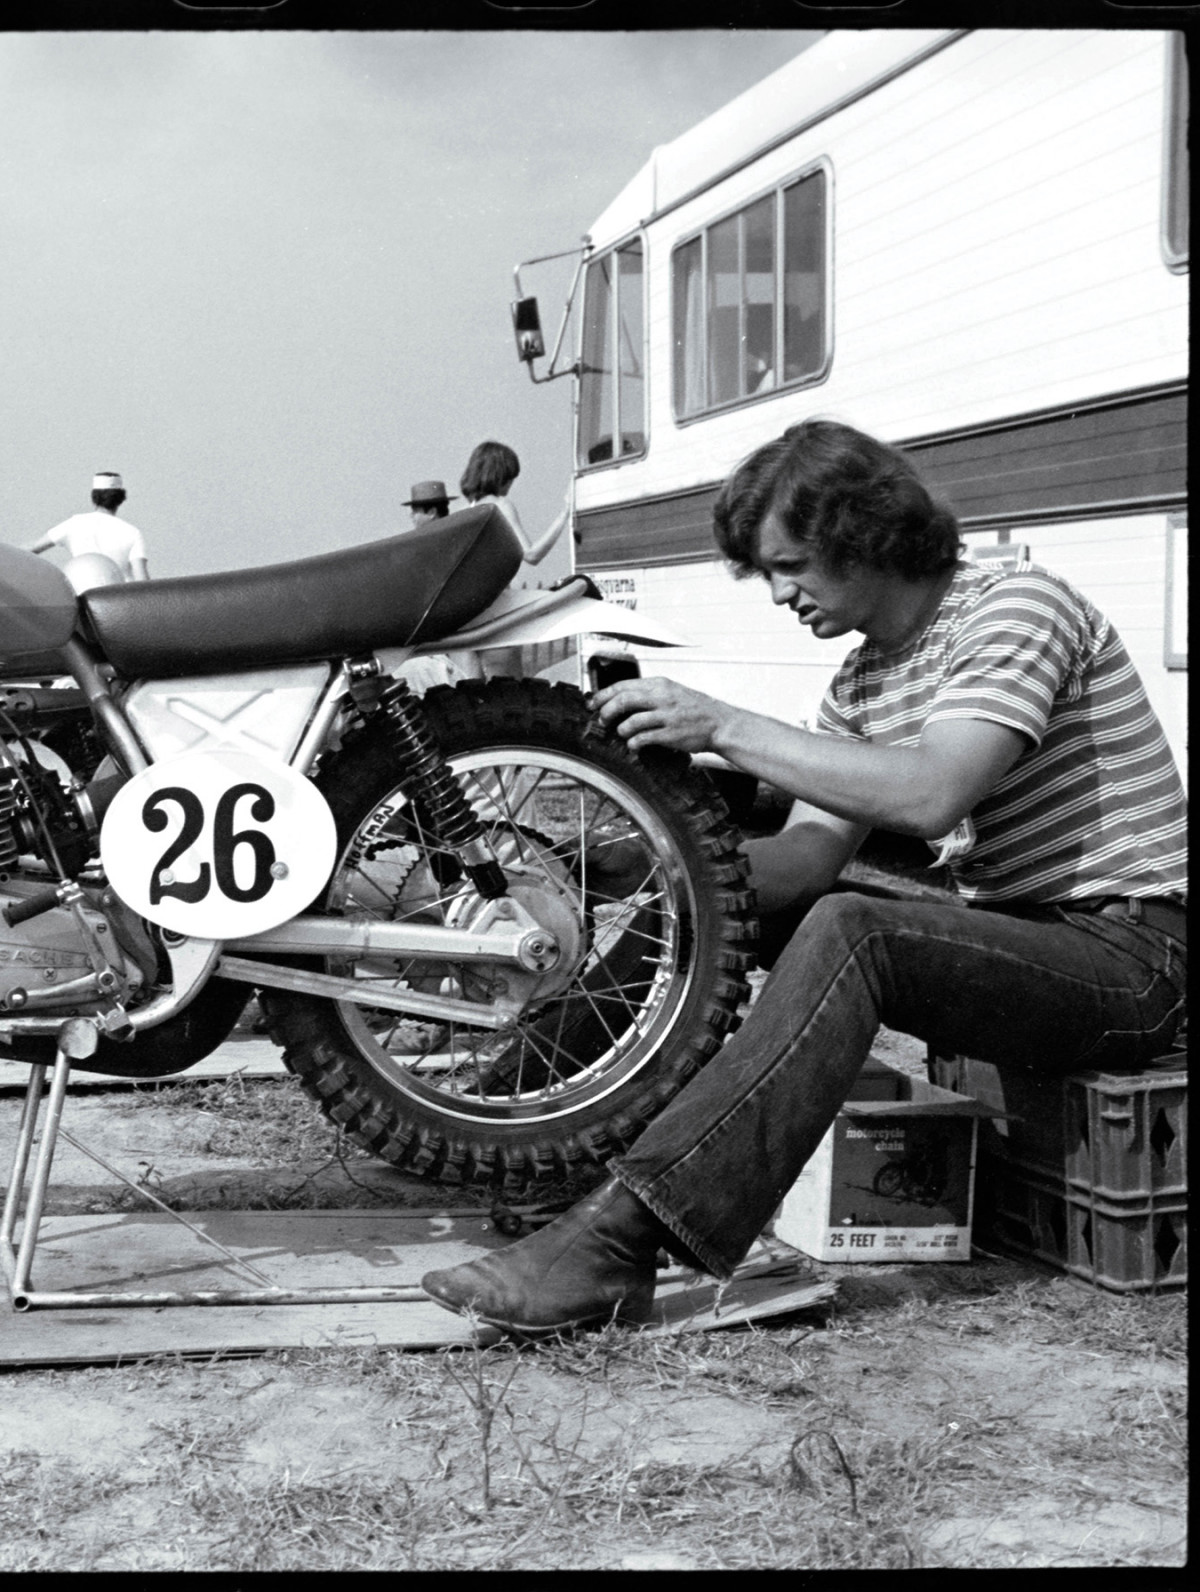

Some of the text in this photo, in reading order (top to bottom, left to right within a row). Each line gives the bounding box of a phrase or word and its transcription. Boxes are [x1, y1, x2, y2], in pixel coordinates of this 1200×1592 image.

[142, 782, 277, 906] 26
[846, 1127, 906, 1140] motorcycle
[874, 1140, 905, 1151] chain
[829, 1233, 845, 1248] 25
[850, 1233, 877, 1248] FEET
